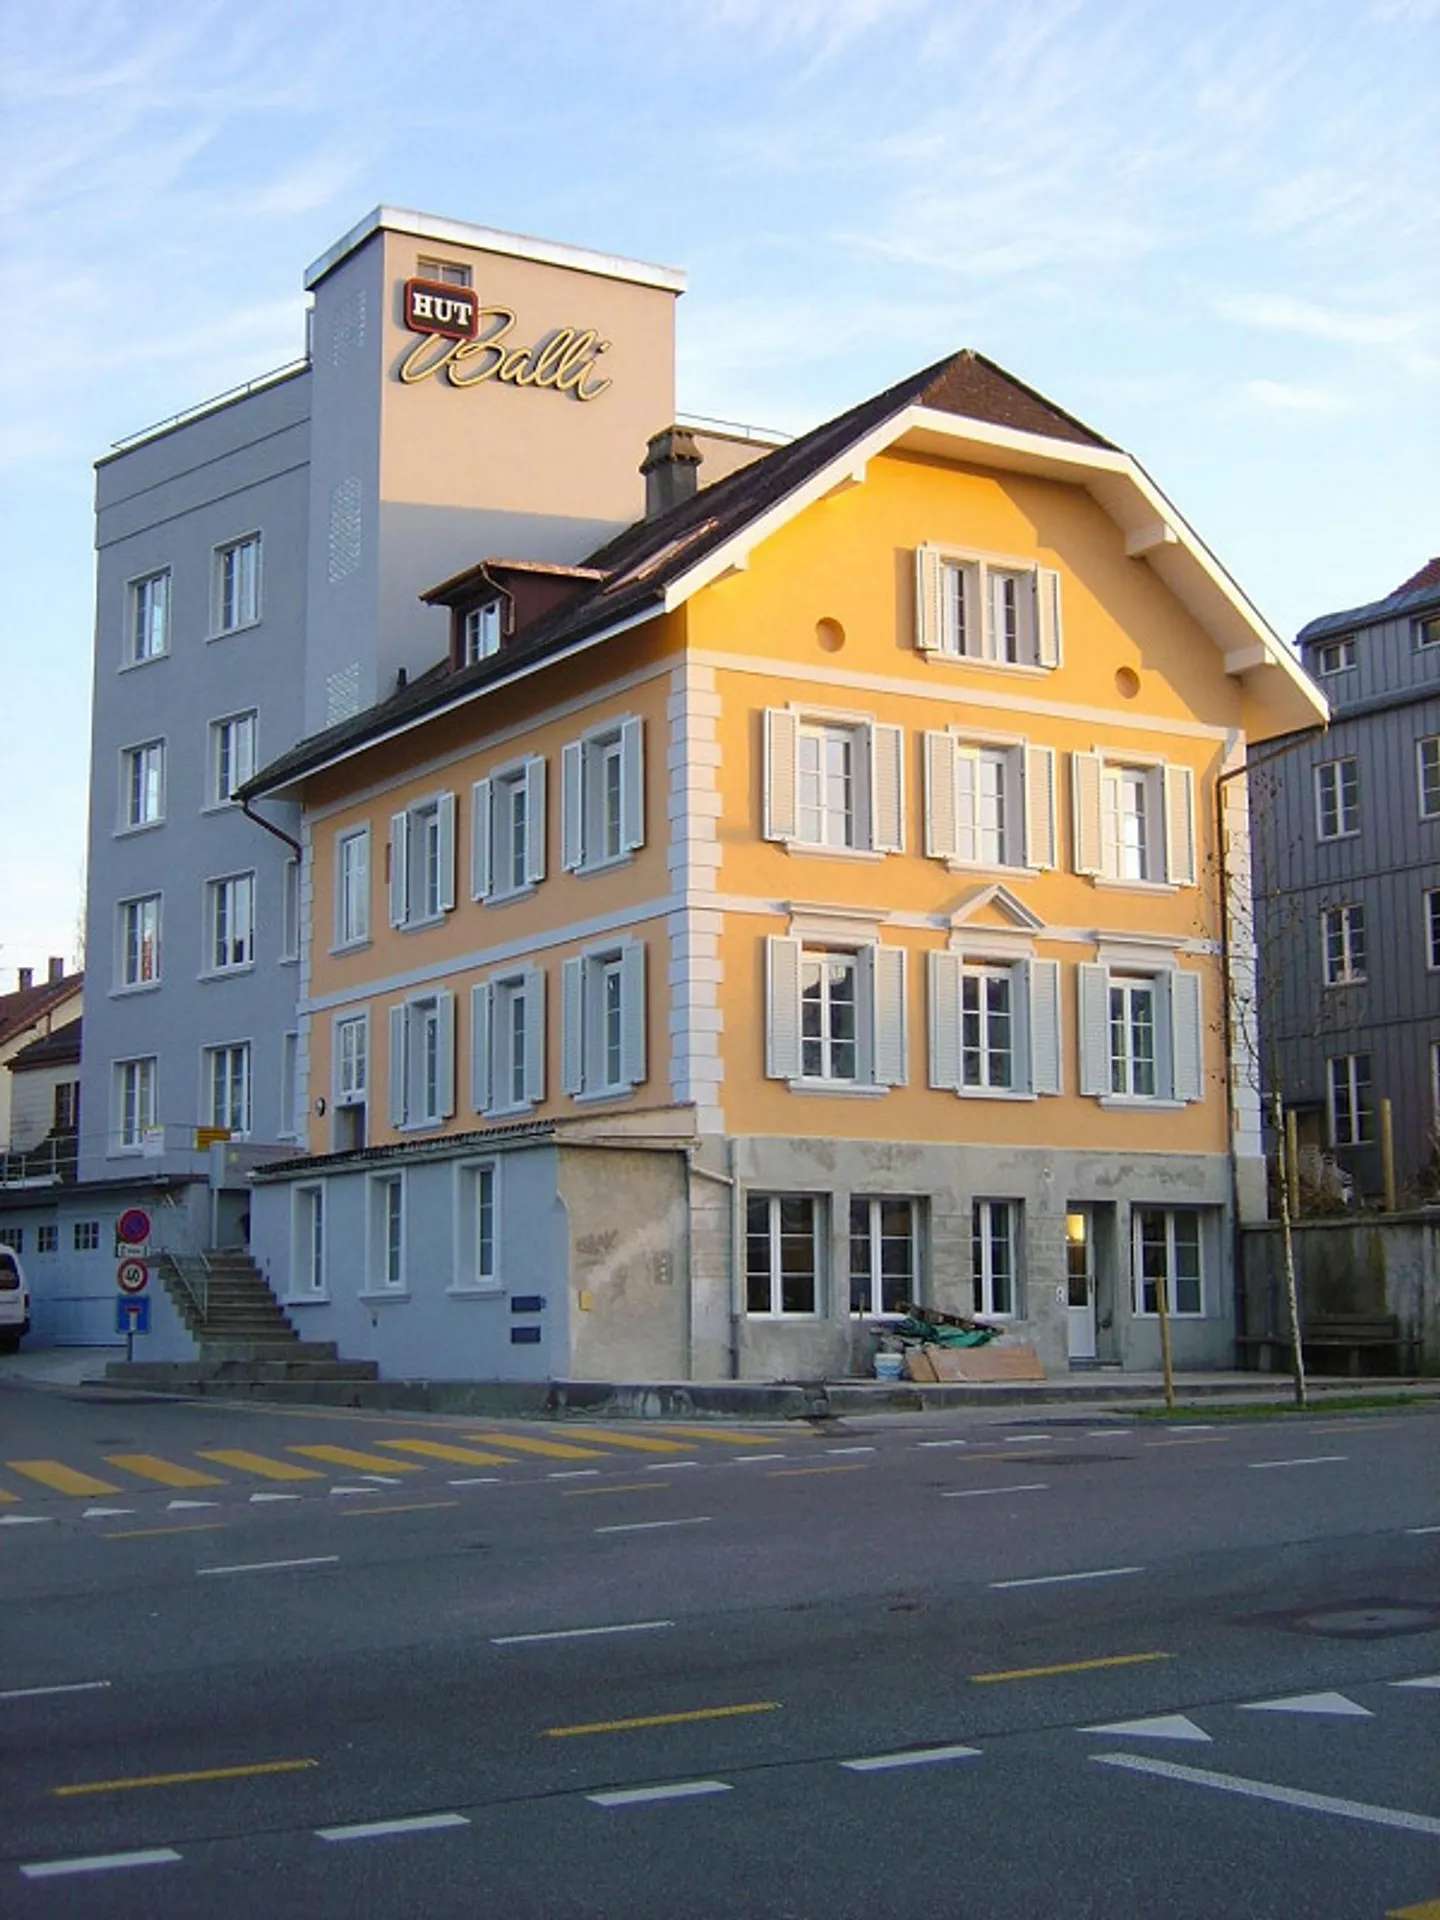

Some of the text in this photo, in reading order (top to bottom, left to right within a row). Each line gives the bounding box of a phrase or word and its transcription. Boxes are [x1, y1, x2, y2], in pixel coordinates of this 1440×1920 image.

[412, 291, 472, 326] HUT
[400, 305, 613, 402] Balli
[125, 1267, 141, 1283] 40
